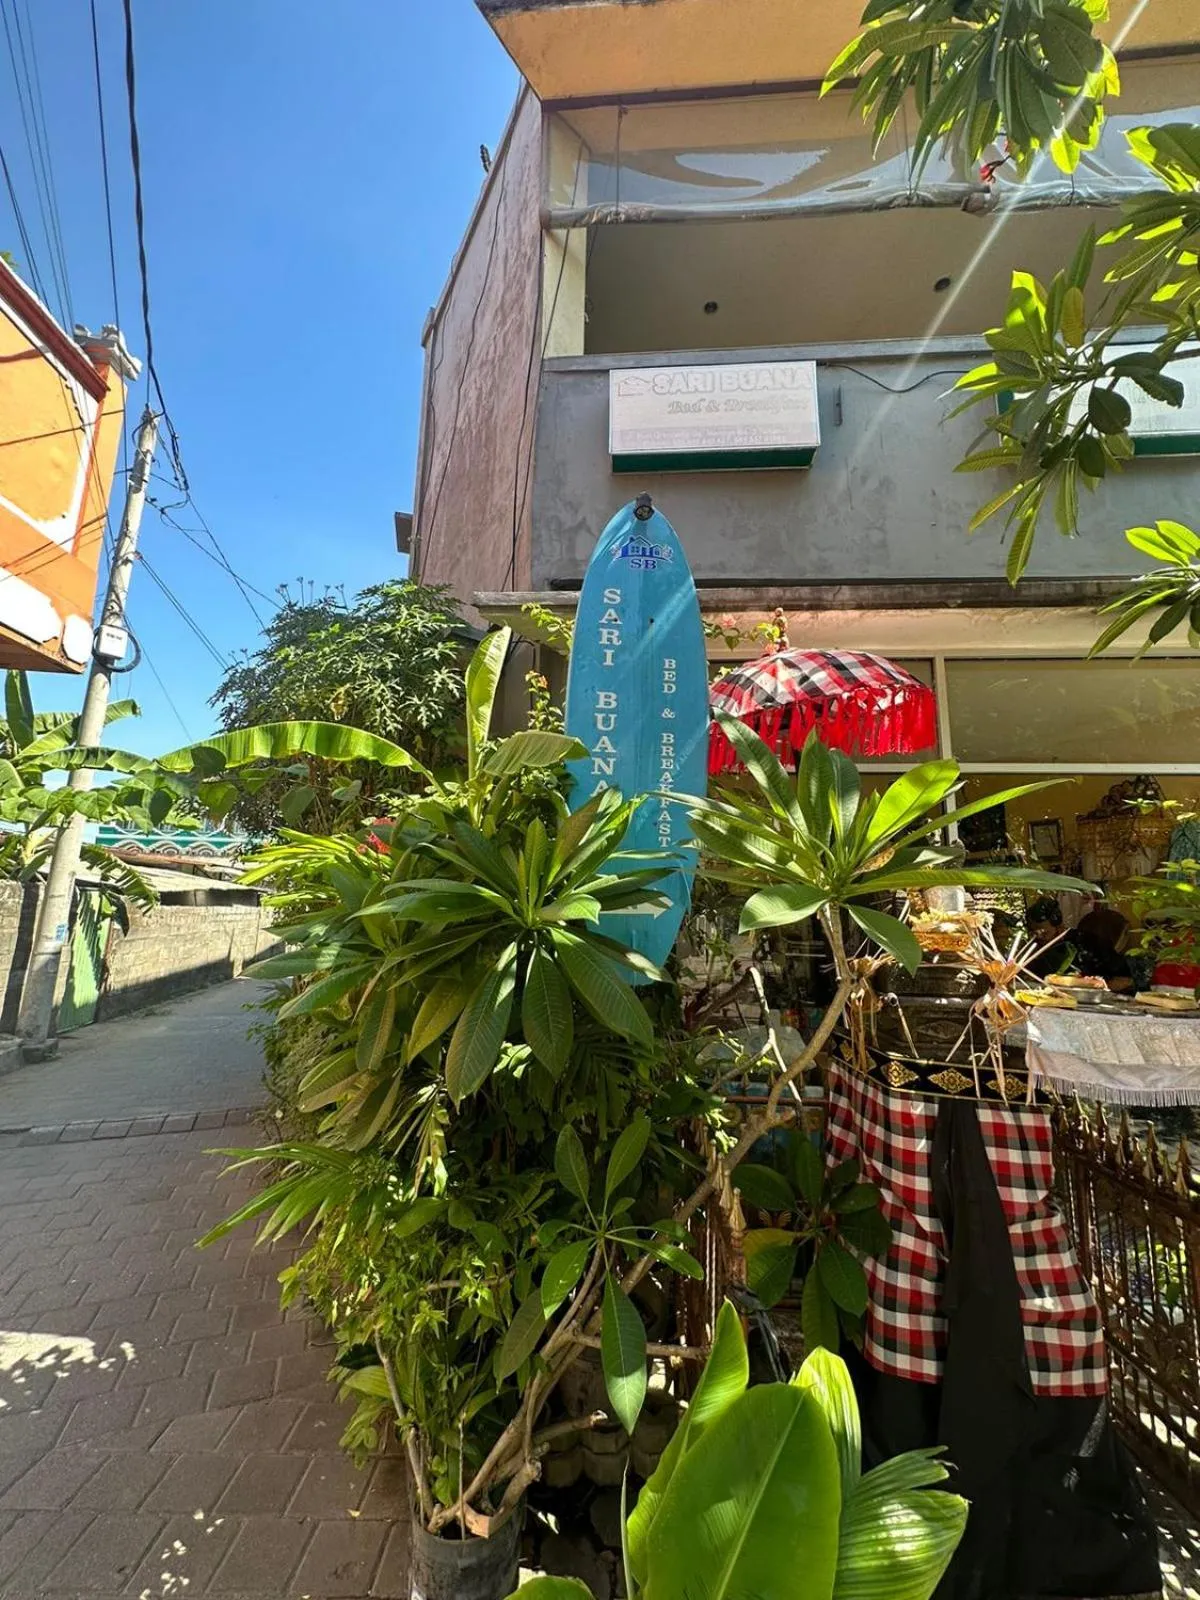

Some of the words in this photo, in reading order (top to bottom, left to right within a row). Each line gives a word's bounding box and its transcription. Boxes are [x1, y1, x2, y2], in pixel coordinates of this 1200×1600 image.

[652, 370, 715, 395] SARI
[720, 366, 814, 392] BUANA
[667, 398, 706, 414] Bed
[707, 399, 720, 413] &
[630, 558, 657, 569] SB
[598, 588, 623, 666] SARI
[663, 658, 677, 694] BED
[661, 707, 676, 719] &
